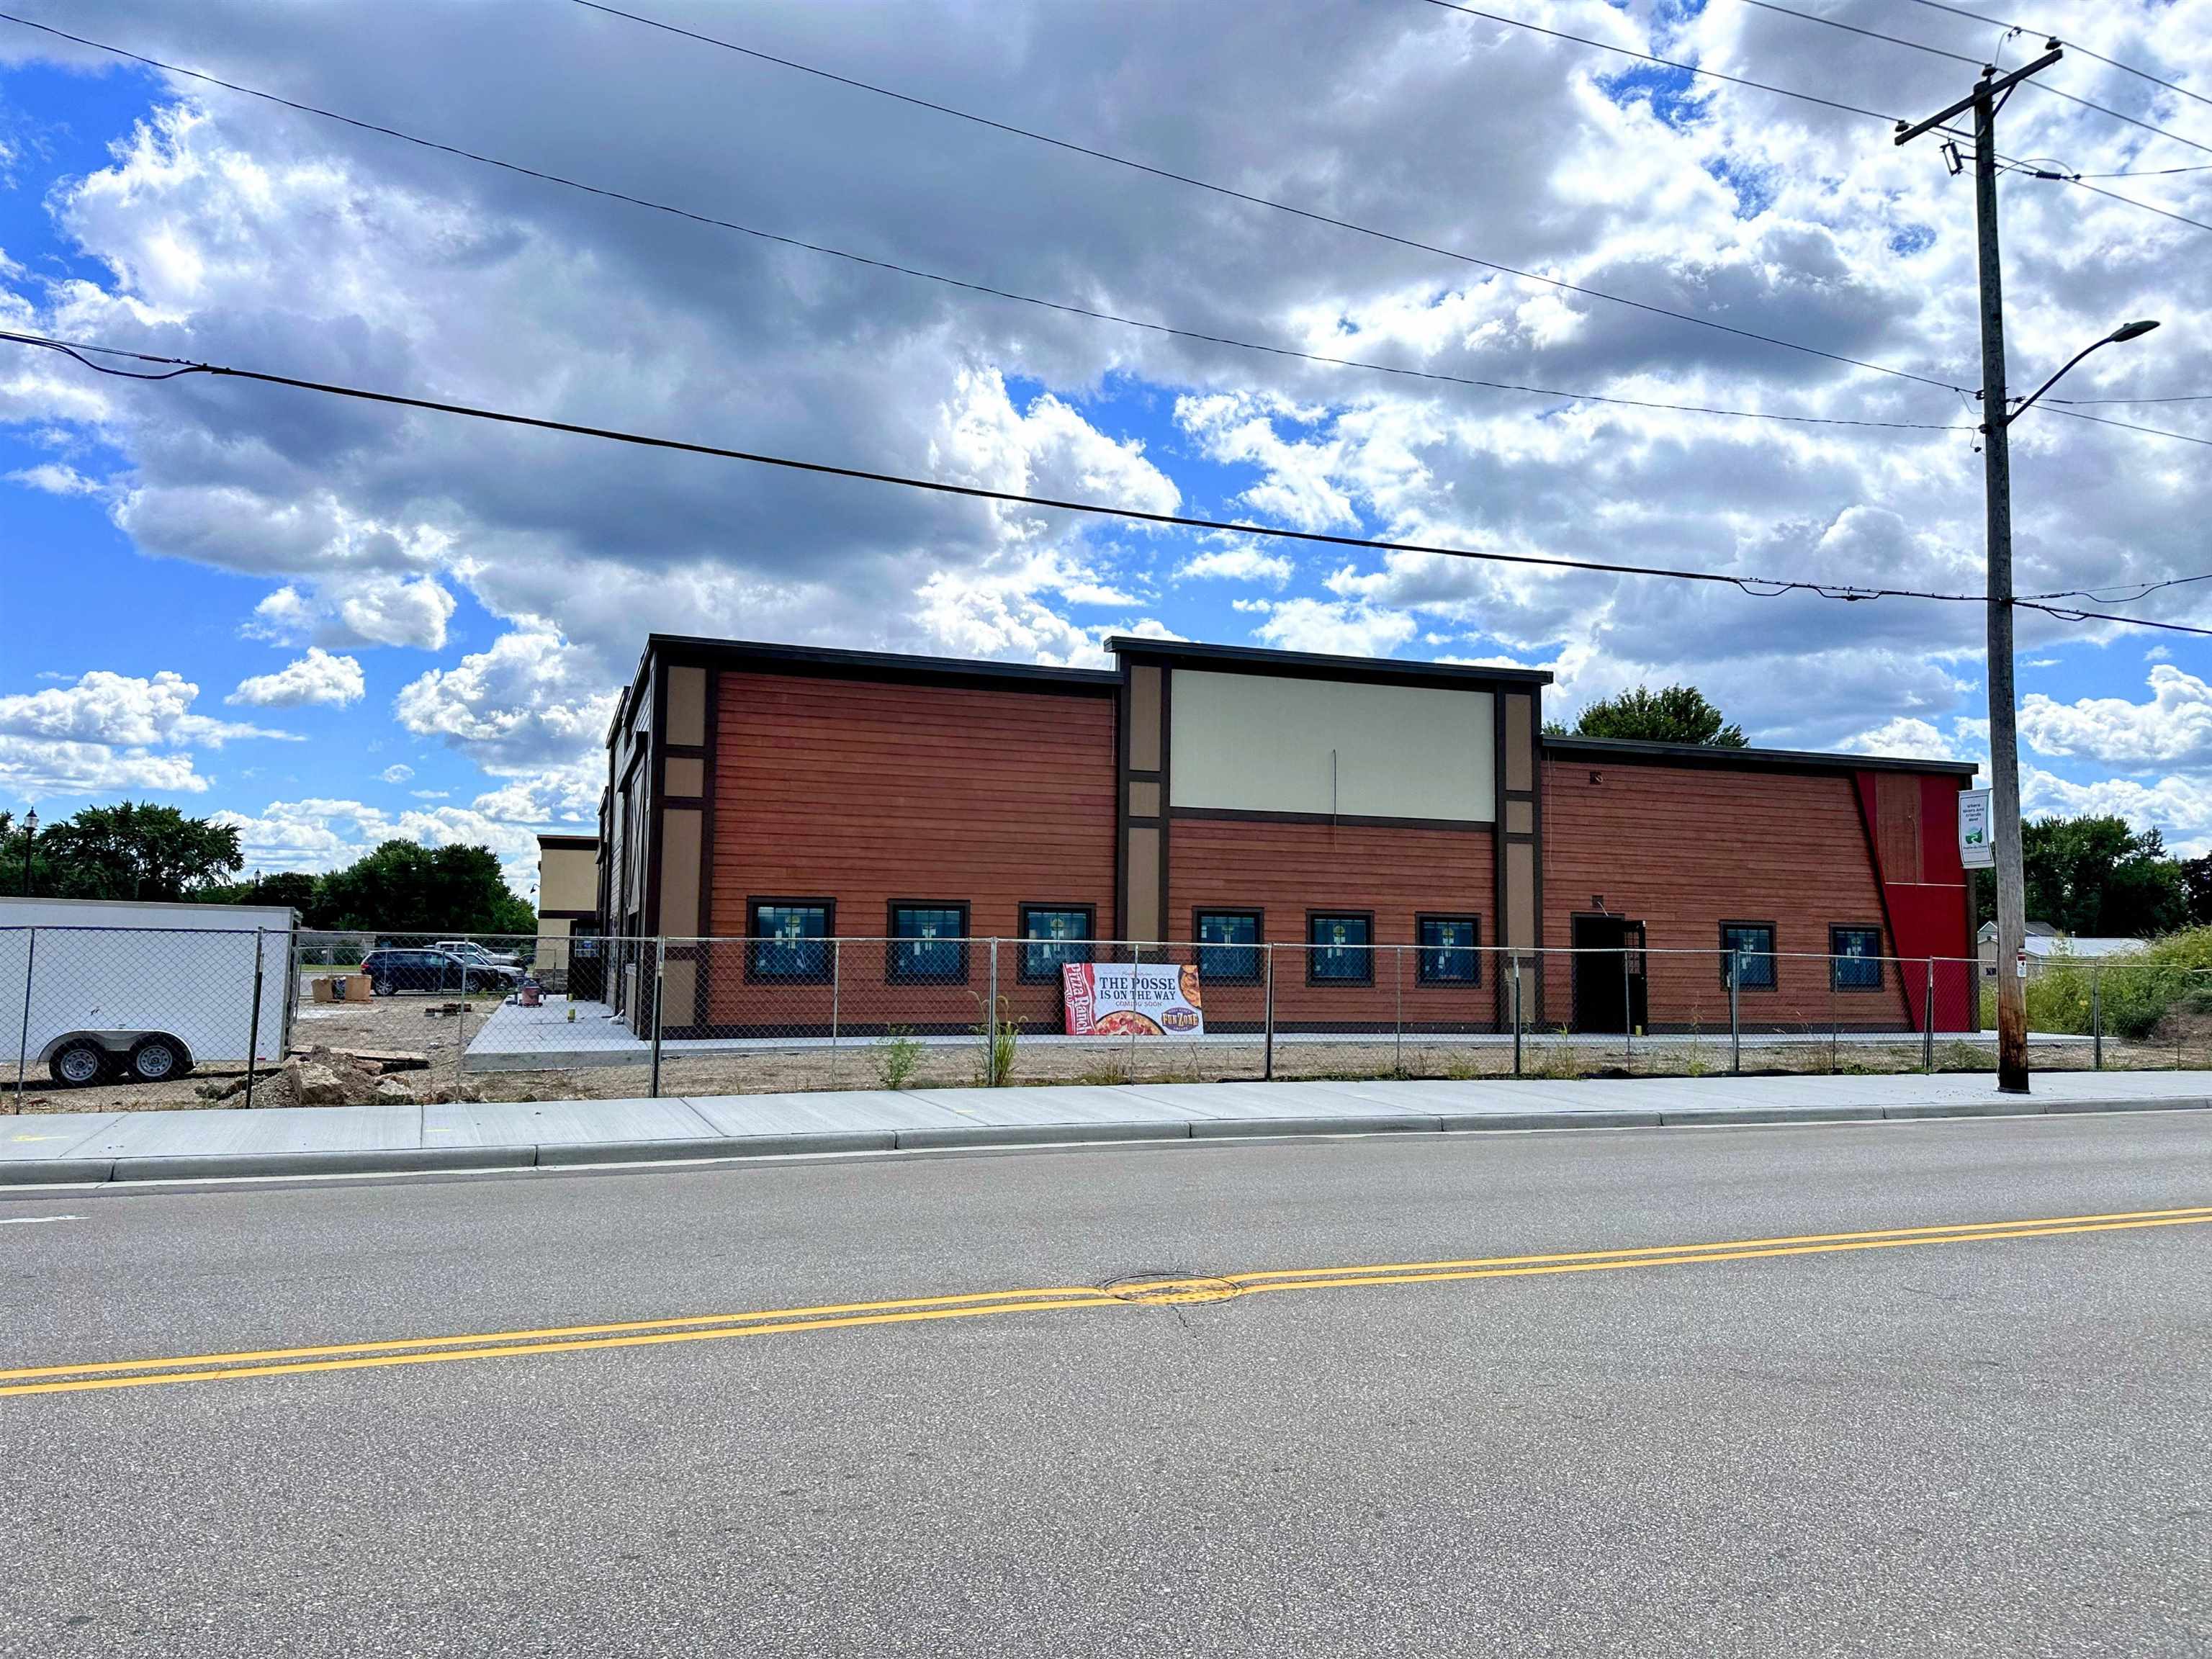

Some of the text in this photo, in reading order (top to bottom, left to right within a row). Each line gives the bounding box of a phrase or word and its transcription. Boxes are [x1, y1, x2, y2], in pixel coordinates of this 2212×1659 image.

[1100, 977, 1175, 990] THE POSSE
[1066, 963, 1093, 1035] Pizza Ranch
[1100, 990, 1175, 1000] IS ON THE WAY
